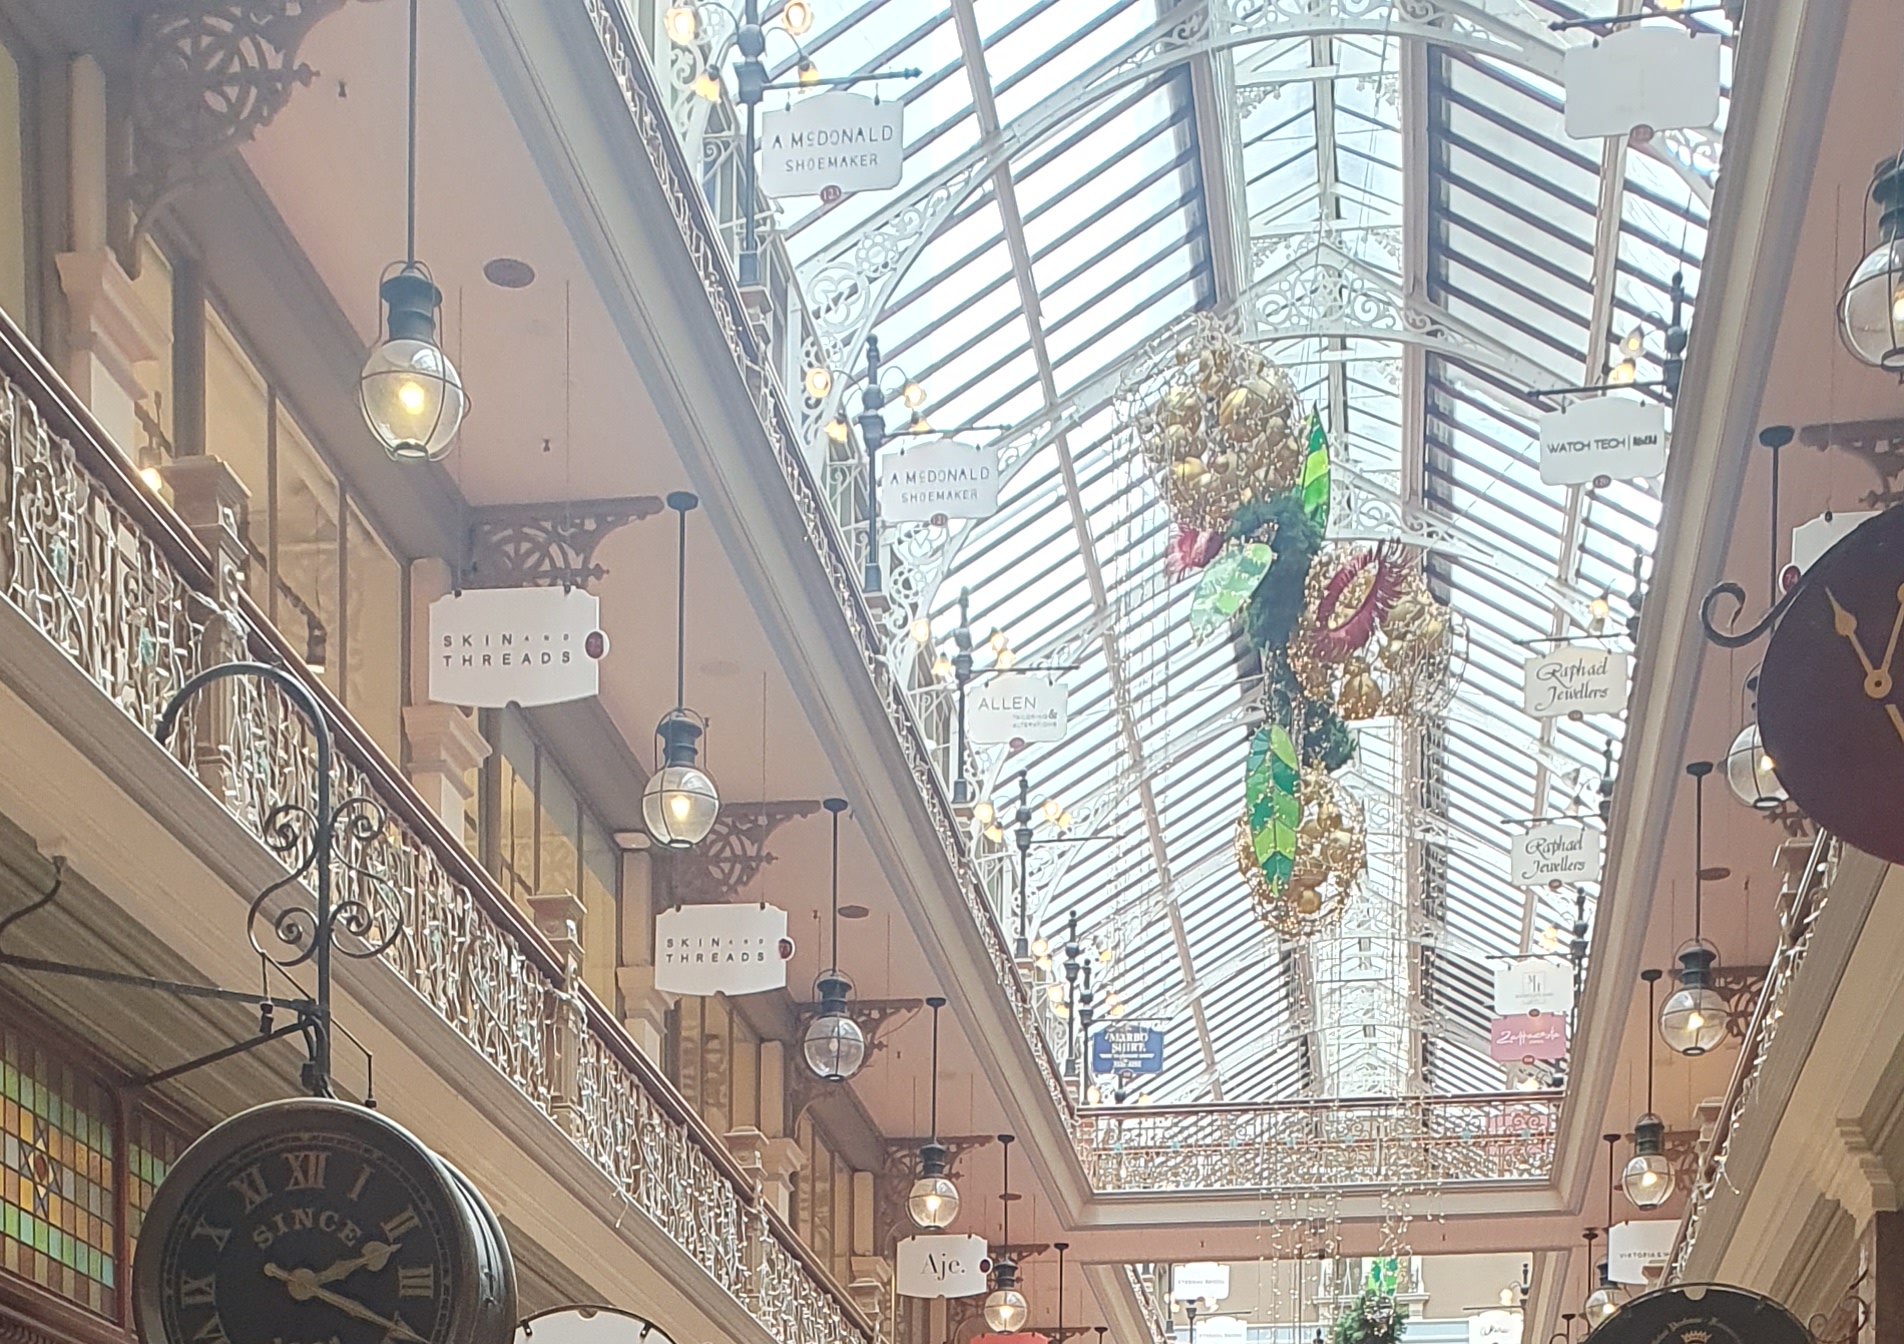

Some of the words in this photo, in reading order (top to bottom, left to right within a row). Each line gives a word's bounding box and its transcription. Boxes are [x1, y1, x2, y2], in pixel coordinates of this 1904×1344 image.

[771, 134, 783, 149] A
[785, 153, 879, 172] SHOEMAKER
[1547, 440, 1591, 454] WATCH
[1594, 438, 1626, 450] TECH
[890, 472, 900, 485] A
[901, 489, 978, 503] SHOEMAKER
[443, 633, 512, 648] SKIN
[443, 651, 571, 667] THREADS
[1534, 680, 1609, 712] Jewellers
[978, 697, 1037, 711] ALLEN
[1048, 709, 1058, 719] &
[1521, 855, 1586, 879] Jewellers
[666, 938, 720, 949] SKIN
[665, 952, 765, 963] THREADS
[282, 1151, 330, 1191] XII
[253, 1207, 362, 1249] SINCE
